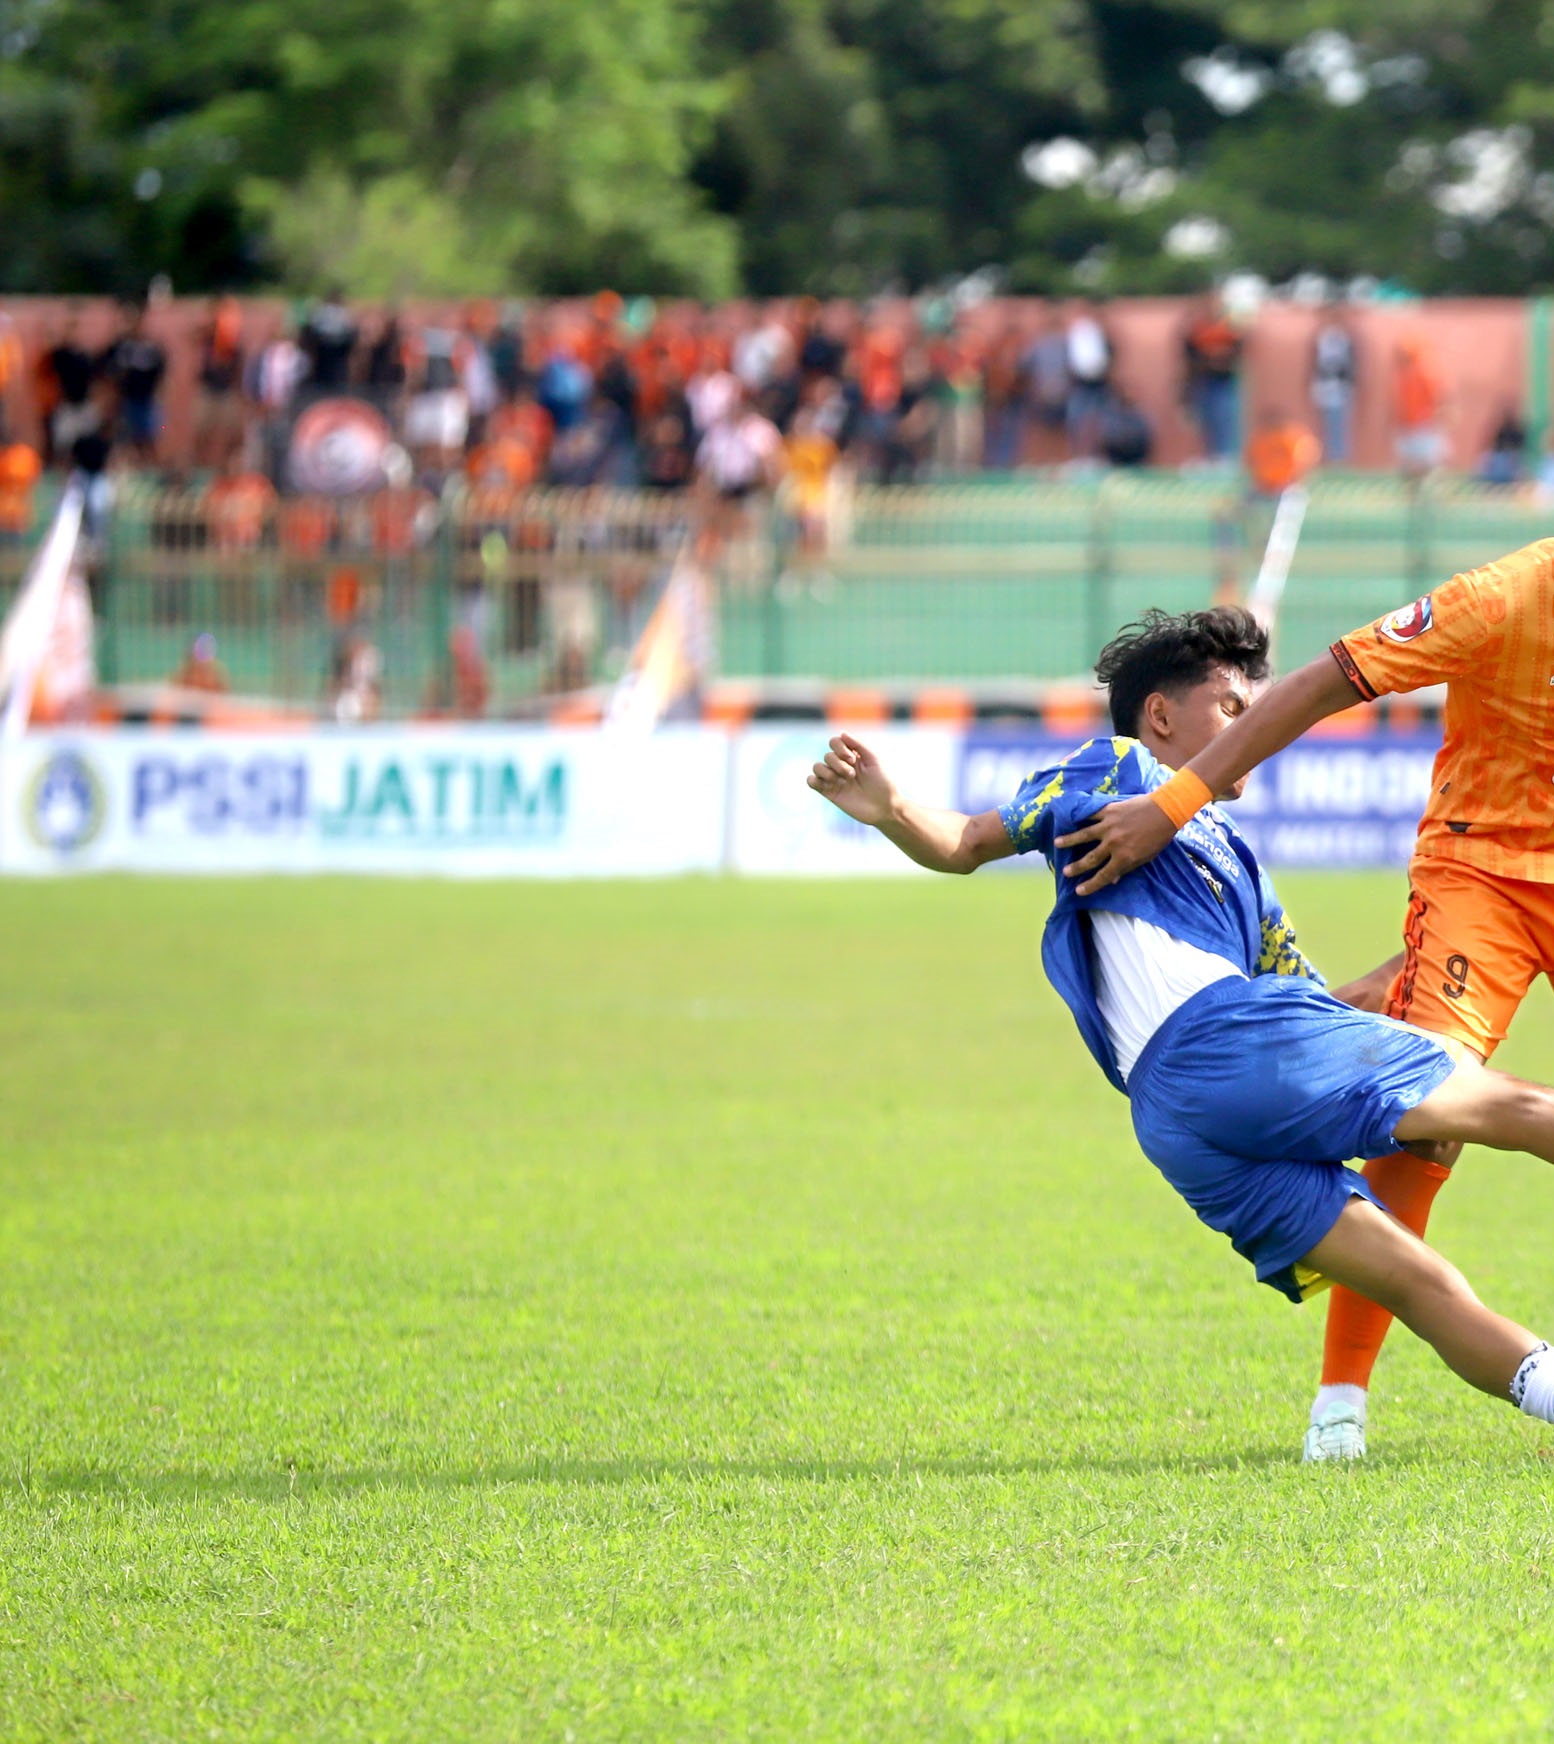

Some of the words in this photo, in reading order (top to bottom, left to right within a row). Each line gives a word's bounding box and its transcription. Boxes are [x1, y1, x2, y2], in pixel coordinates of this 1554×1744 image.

[131, 755, 309, 835] PSSI
[321, 755, 568, 838] JATIM
[1442, 953, 1469, 999] 9
